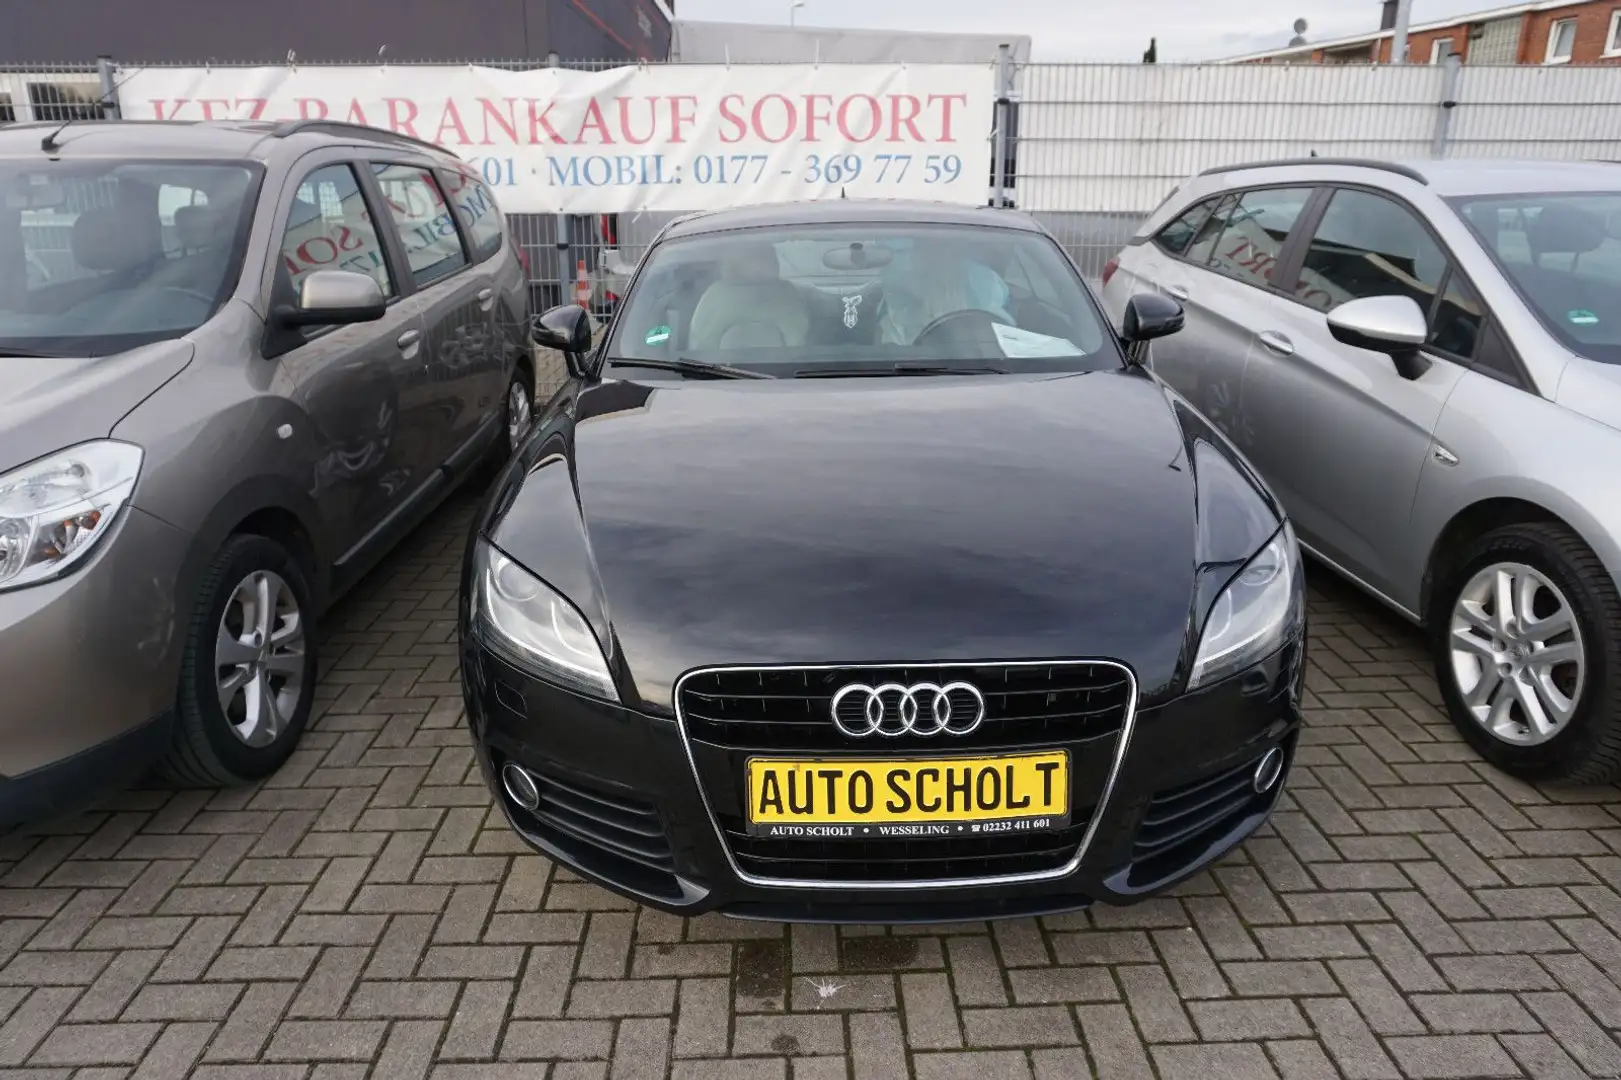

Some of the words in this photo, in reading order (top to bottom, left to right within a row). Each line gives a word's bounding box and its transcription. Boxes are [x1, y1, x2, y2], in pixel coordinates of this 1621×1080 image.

[148, 95, 698, 145] ARANKAUF
[718, 92, 967, 143] SOFORT
[468, 155, 517, 186] 01
[546, 154, 682, 186] MOBIL:
[693, 154, 769, 184] 0177
[804, 154, 862, 184] 369
[872, 154, 912, 184] 77
[923, 154, 962, 184] 59
[759, 769, 874, 815] AUTO
[885, 761, 1060, 814] SCHOLT
[770, 826, 803, 835] AUTO
[806, 826, 854, 836] SCHOLT
[879, 825, 949, 835] WESSELING
[982, 821, 1012, 832] 02232
[1014, 819, 1030, 831] 411
[1033, 818, 1050, 828] 601
